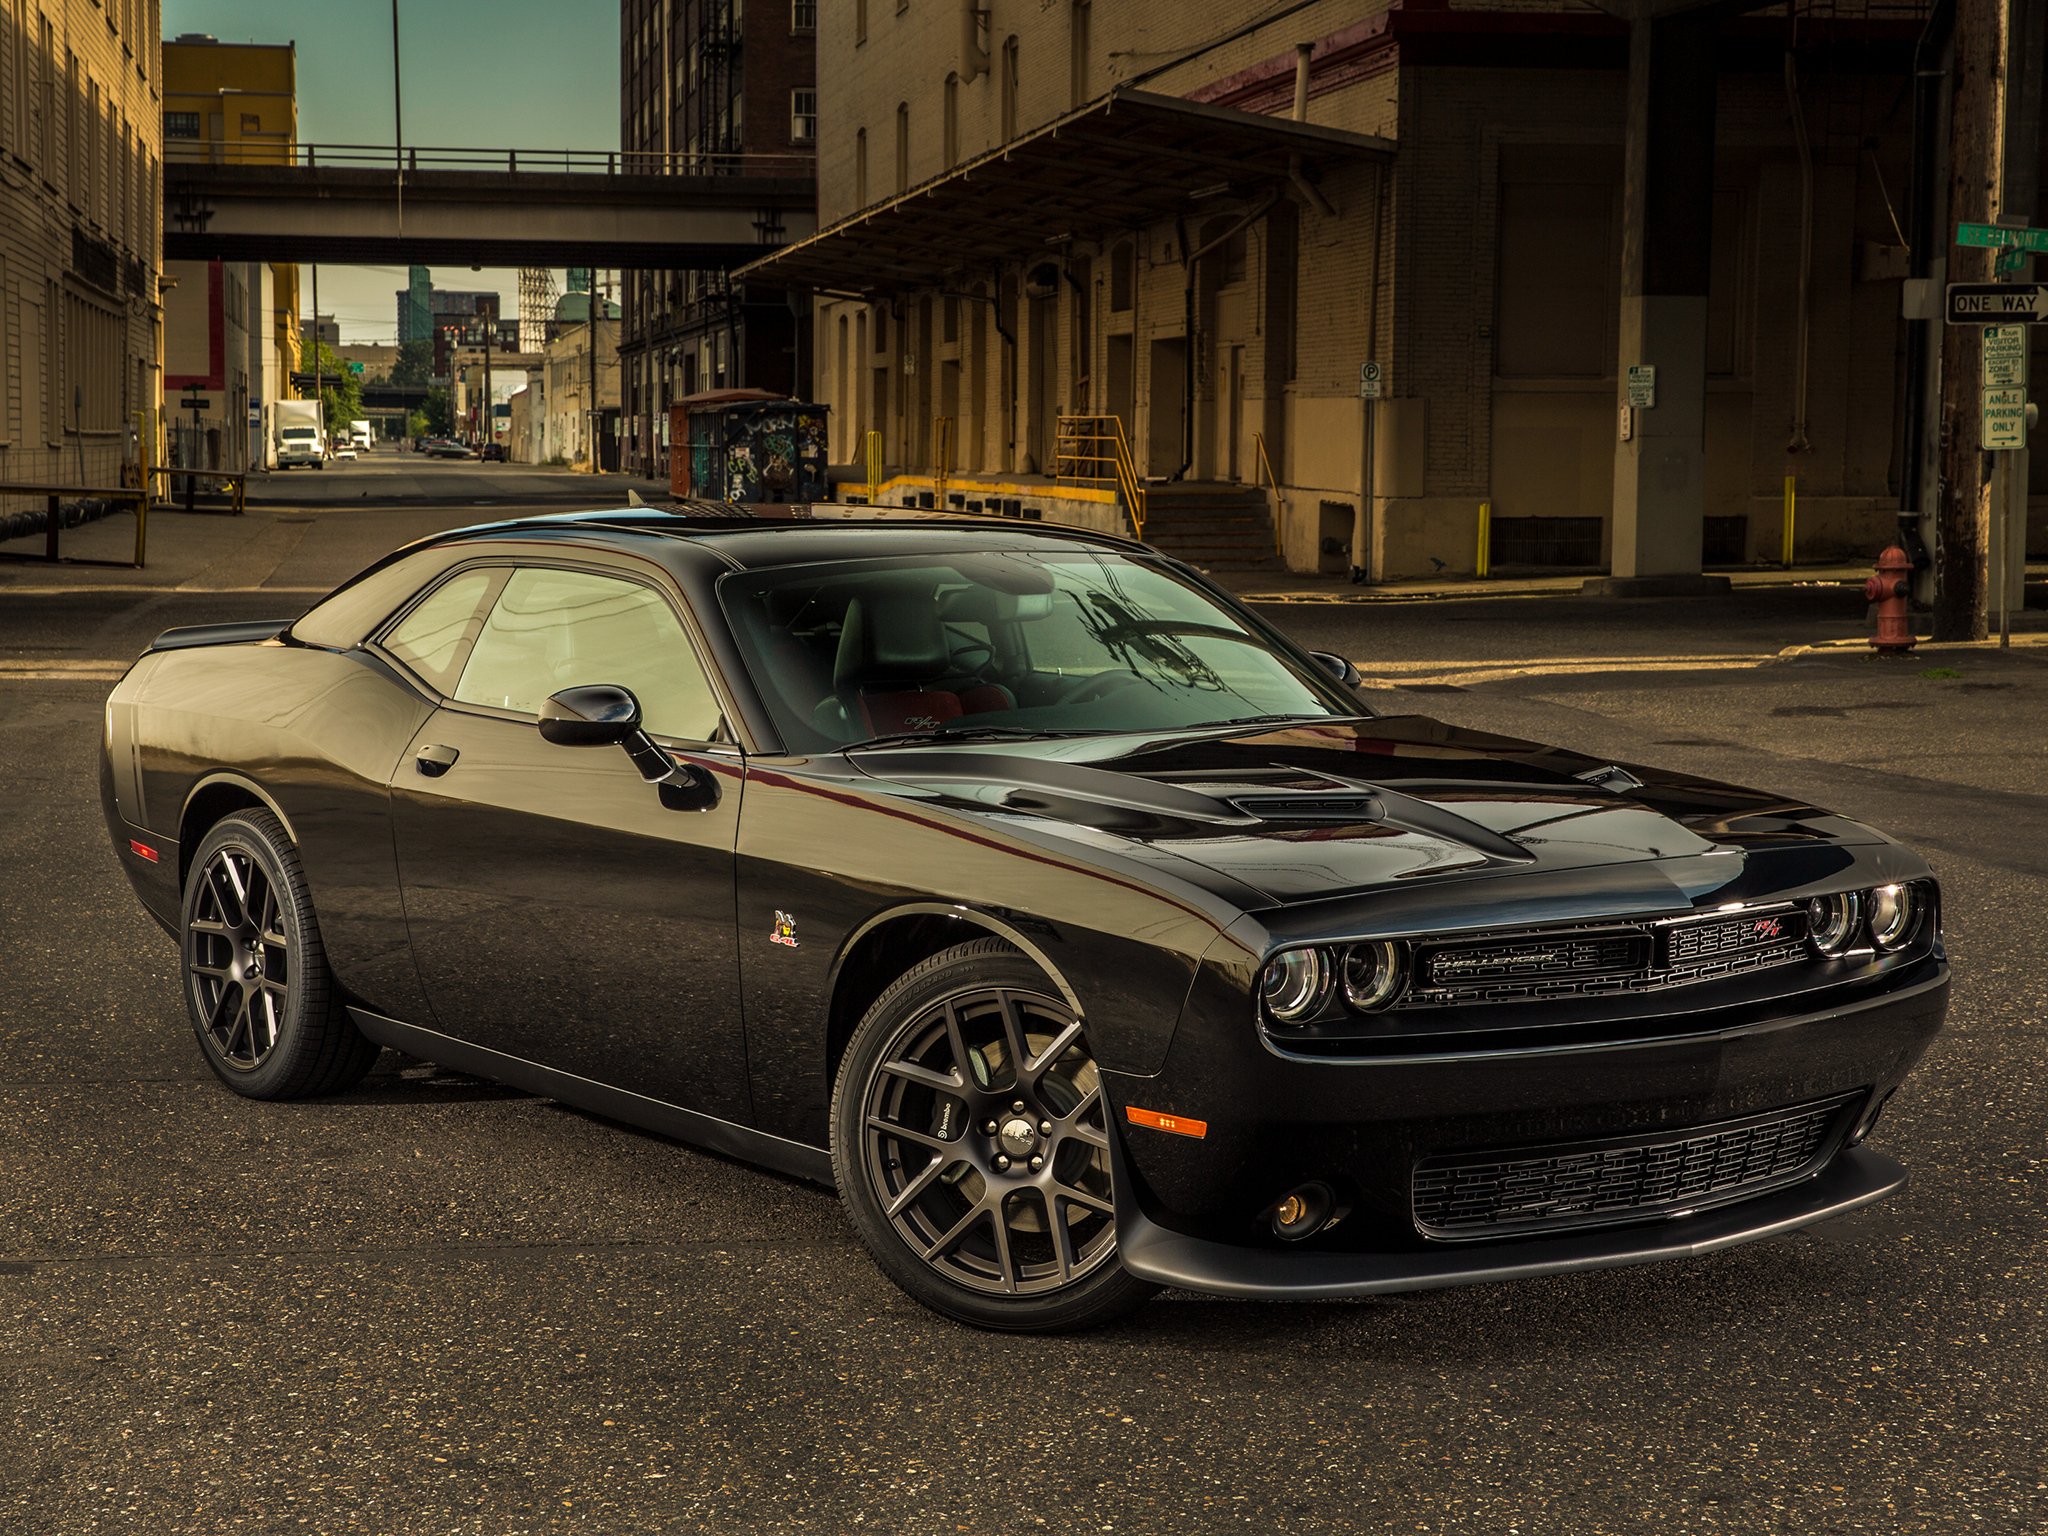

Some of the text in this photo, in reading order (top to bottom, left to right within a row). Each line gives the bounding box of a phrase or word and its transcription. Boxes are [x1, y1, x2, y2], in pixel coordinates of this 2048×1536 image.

[1967, 227, 1982, 244] SE
[1987, 229, 2039, 247] BELMONT
[1956, 296, 2037, 311] ONE WAY
[1988, 329, 1995, 337] 2
[1988, 337, 2019, 345] VISITOR
[1367, 367, 1375, 377] P
[1989, 394, 2018, 404] ANGLE
[1985, 408, 2023, 418] PARKING
[1992, 422, 2016, 432] ONLY
[904, 716, 941, 730] R/T
[1753, 917, 1784, 941] R/T
[769, 934, 800, 948] 6.4L
[1433, 953, 1556, 970] CHALLENGER
[940, 1102, 952, 1130] brembo
